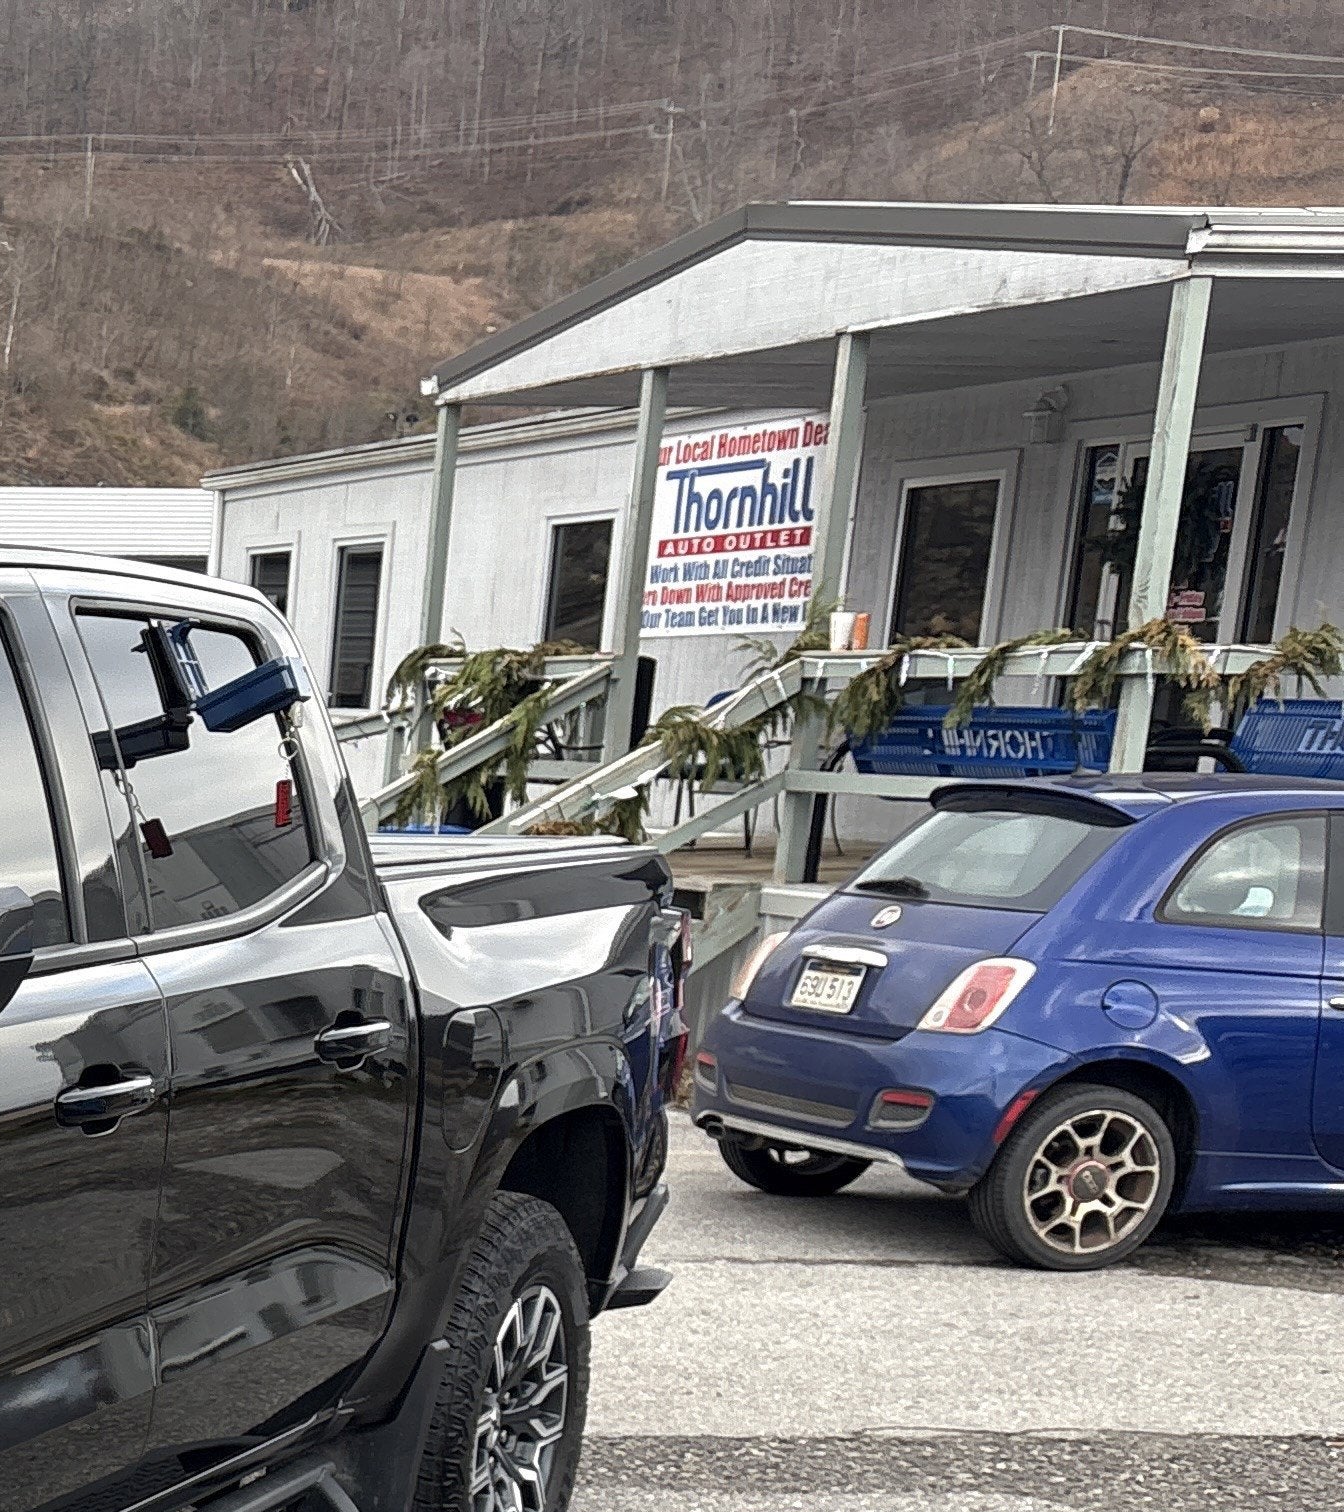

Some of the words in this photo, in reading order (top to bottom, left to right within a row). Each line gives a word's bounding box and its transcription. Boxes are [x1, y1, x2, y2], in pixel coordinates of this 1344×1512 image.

[675, 435, 716, 465] Local
[717, 426, 800, 459] Hometown
[666, 456, 814, 534] Thornhill
[662, 537, 715, 555] AUTO
[724, 530, 805, 551] OUTLET
[650, 563, 680, 584] Work
[682, 559, 710, 582] With
[712, 558, 729, 579] All
[731, 554, 771, 579] Credit
[660, 586, 692, 605] Down
[696, 583, 723, 603] With
[726, 577, 787, 604] Approved
[665, 609, 695, 628] Team
[699, 606, 719, 627] Get
[722, 605, 744, 626] You
[746, 604, 758, 625] In
[762, 602, 769, 624] A
[772, 602, 800, 624] New
